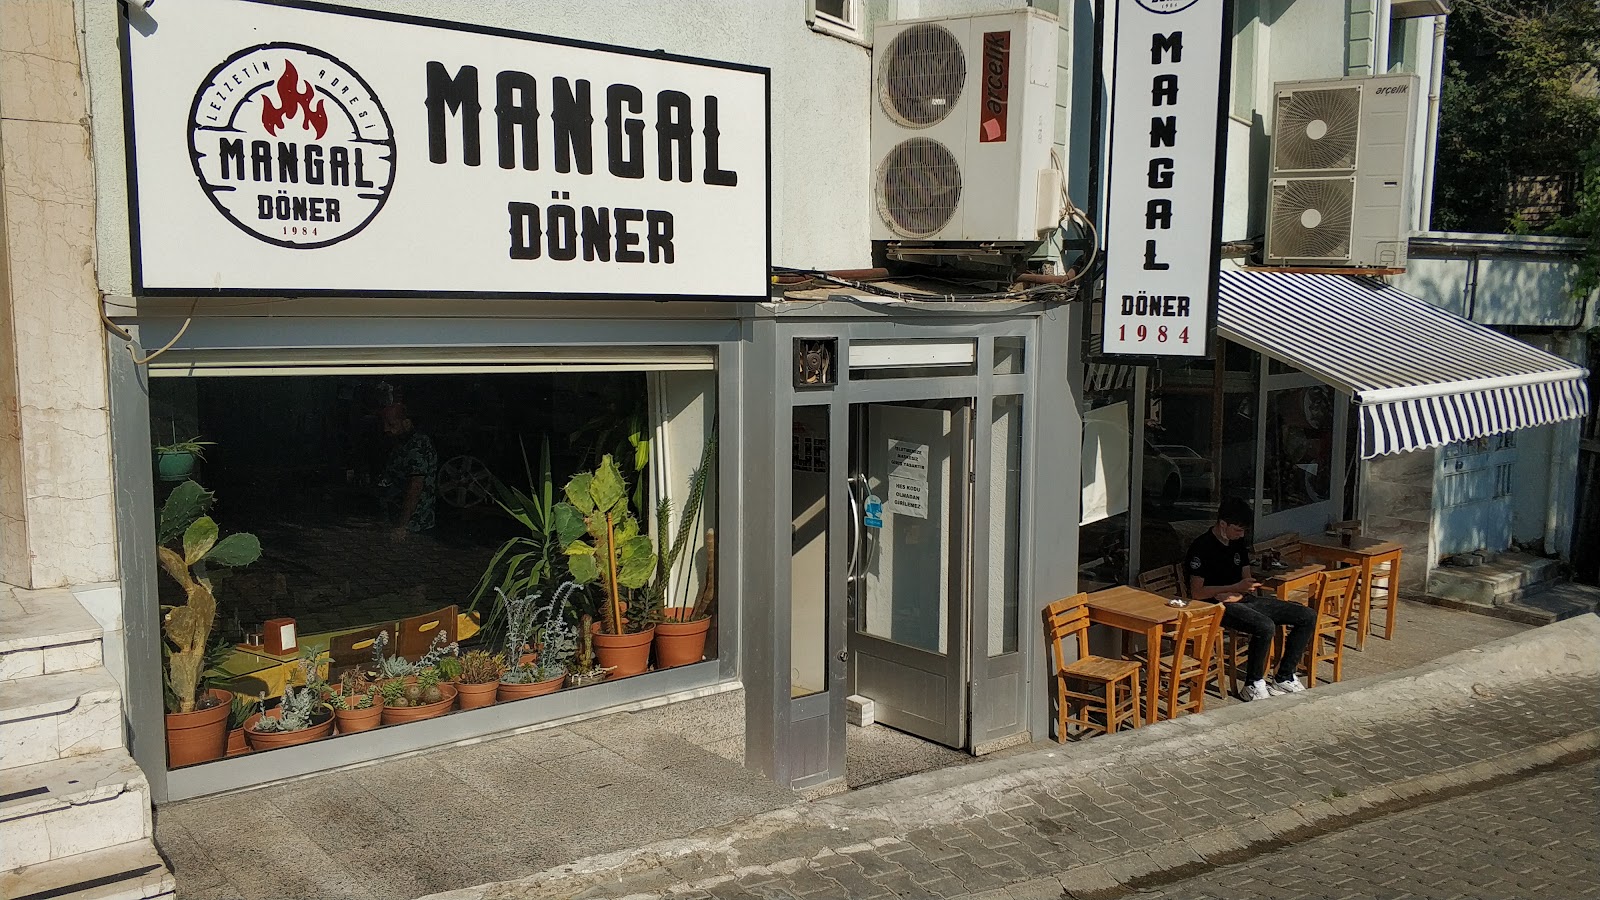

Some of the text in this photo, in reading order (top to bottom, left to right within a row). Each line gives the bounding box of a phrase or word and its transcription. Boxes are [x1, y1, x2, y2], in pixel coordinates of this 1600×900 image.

[206, 61, 376, 130] LEZZETİN ADRESİ
[984, 31, 1008, 115] arçelik
[1375, 84, 1409, 97] arçelik
[424, 60, 738, 187] MANGAL
[219, 136, 374, 188] MANGAL
[1143, 31, 1184, 270] MANGAL
[257, 189, 341, 223] DÖNER
[282, 225, 319, 236] 1984
[508, 190, 675, 264] DÖNER
[1121, 290, 1190, 317] DÖNER
[1119, 324, 1190, 344] 1984
